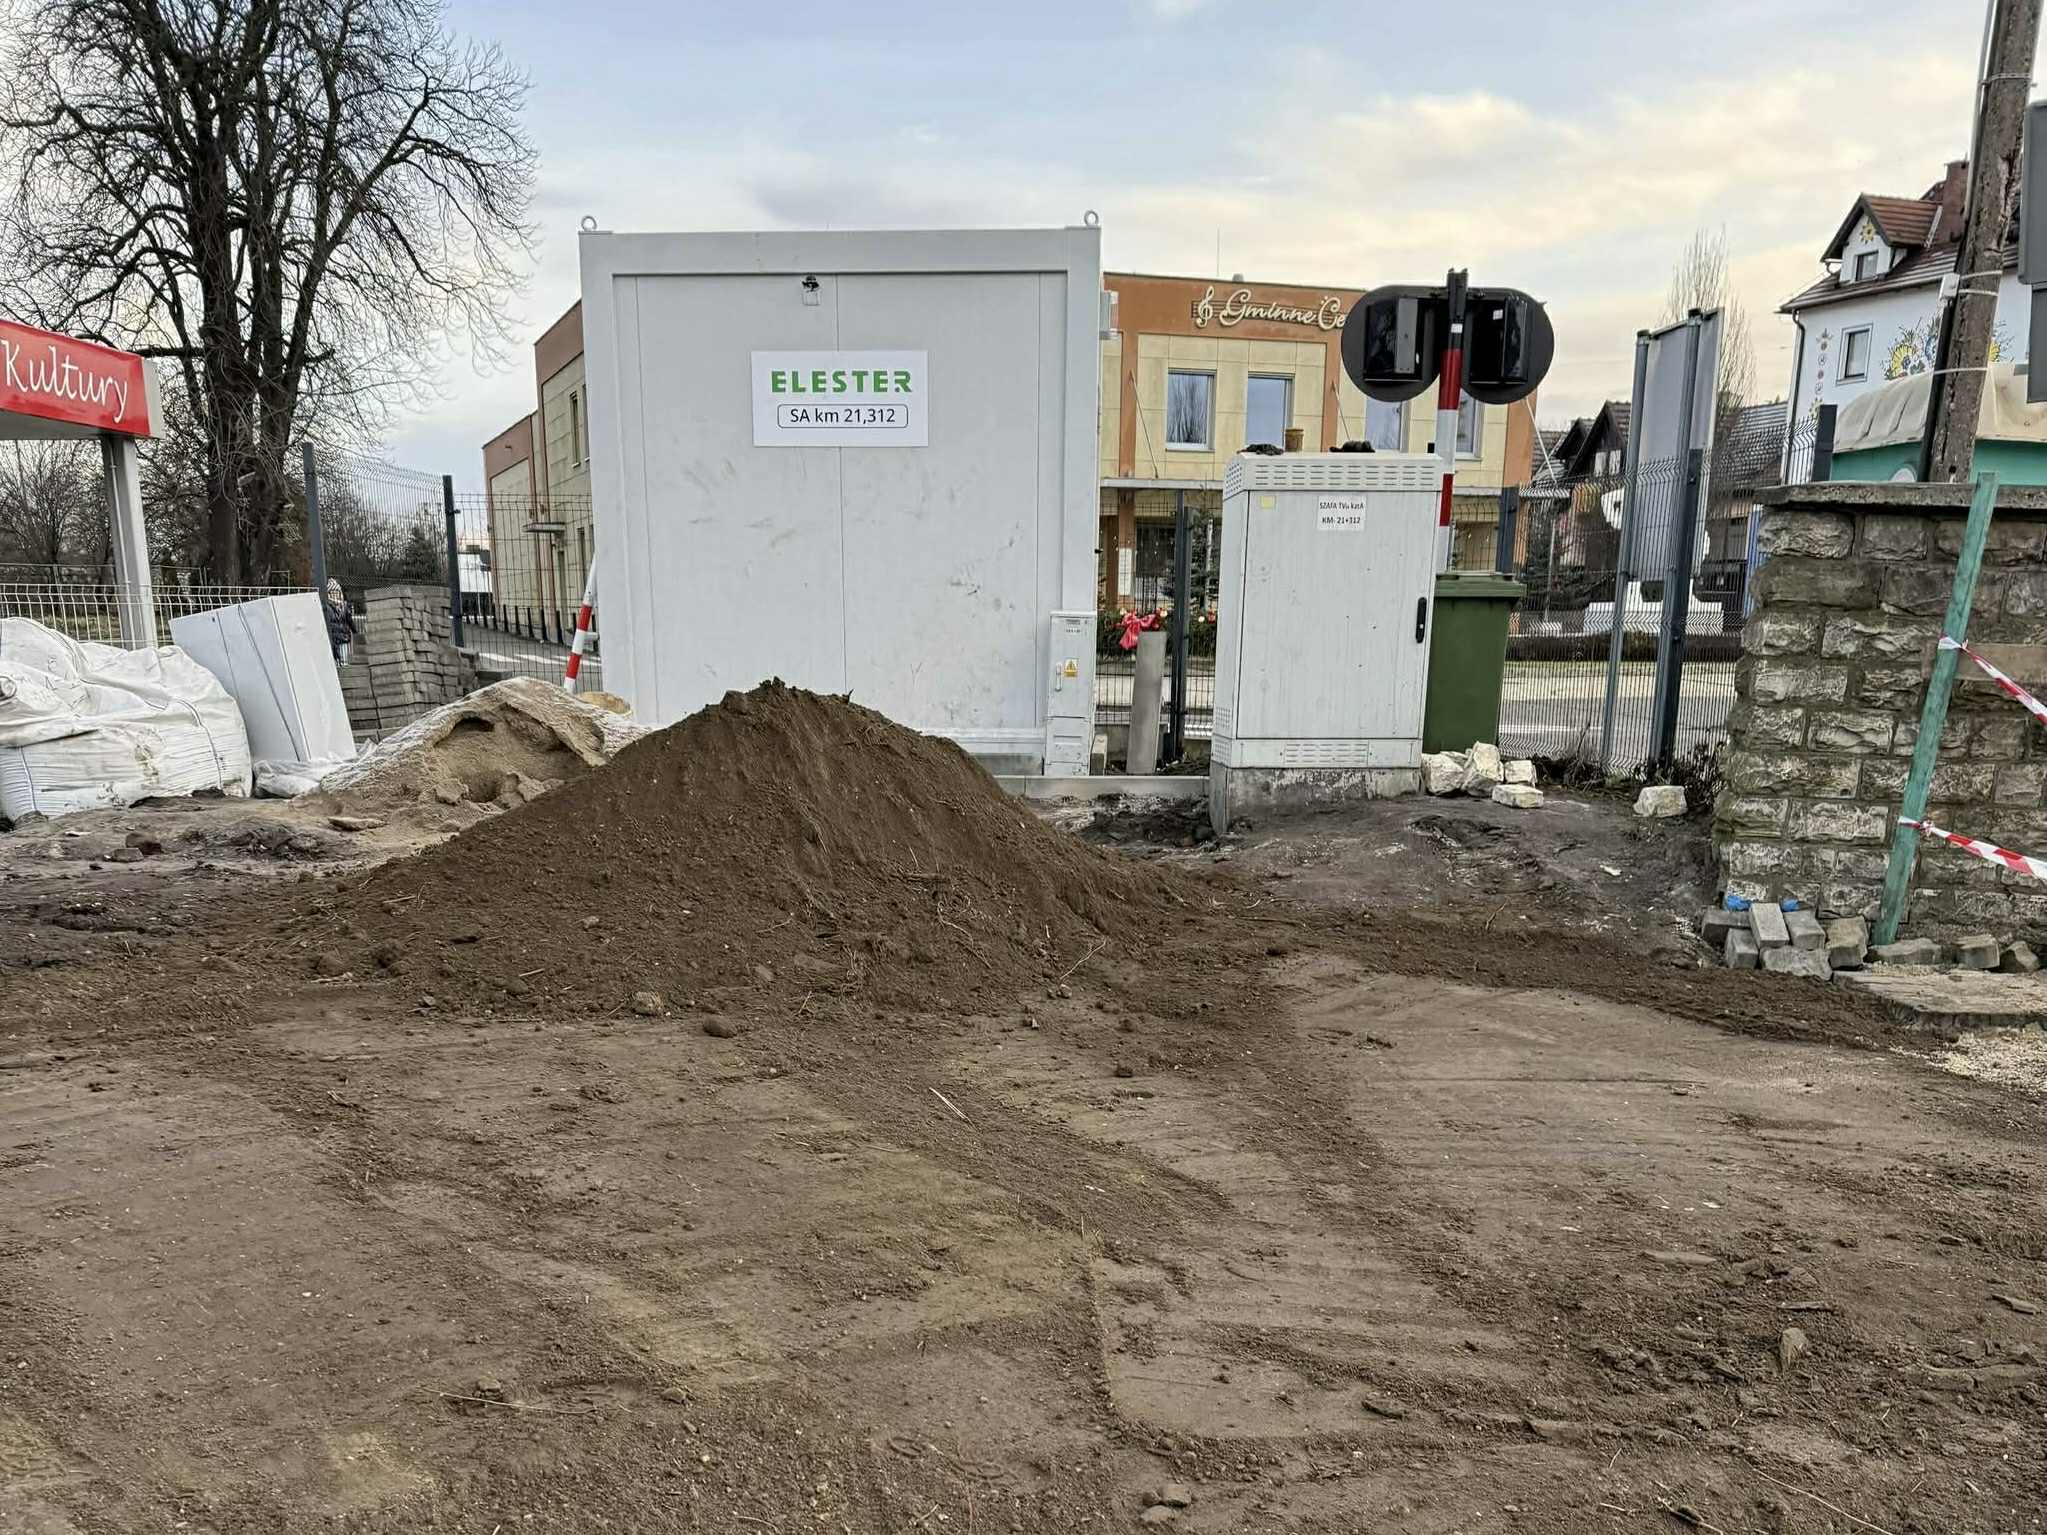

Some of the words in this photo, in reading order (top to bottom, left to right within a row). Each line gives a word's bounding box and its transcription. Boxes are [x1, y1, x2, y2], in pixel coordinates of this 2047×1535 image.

[1219, 289, 1316, 326] Gminne
[1318, 296, 1347, 331] Ce
[1, 339, 128, 424] Kultury
[771, 370, 913, 393] ELESTER
[790, 408, 810, 423] SA
[815, 408, 839, 423] km
[844, 408, 896, 424] 21,312
